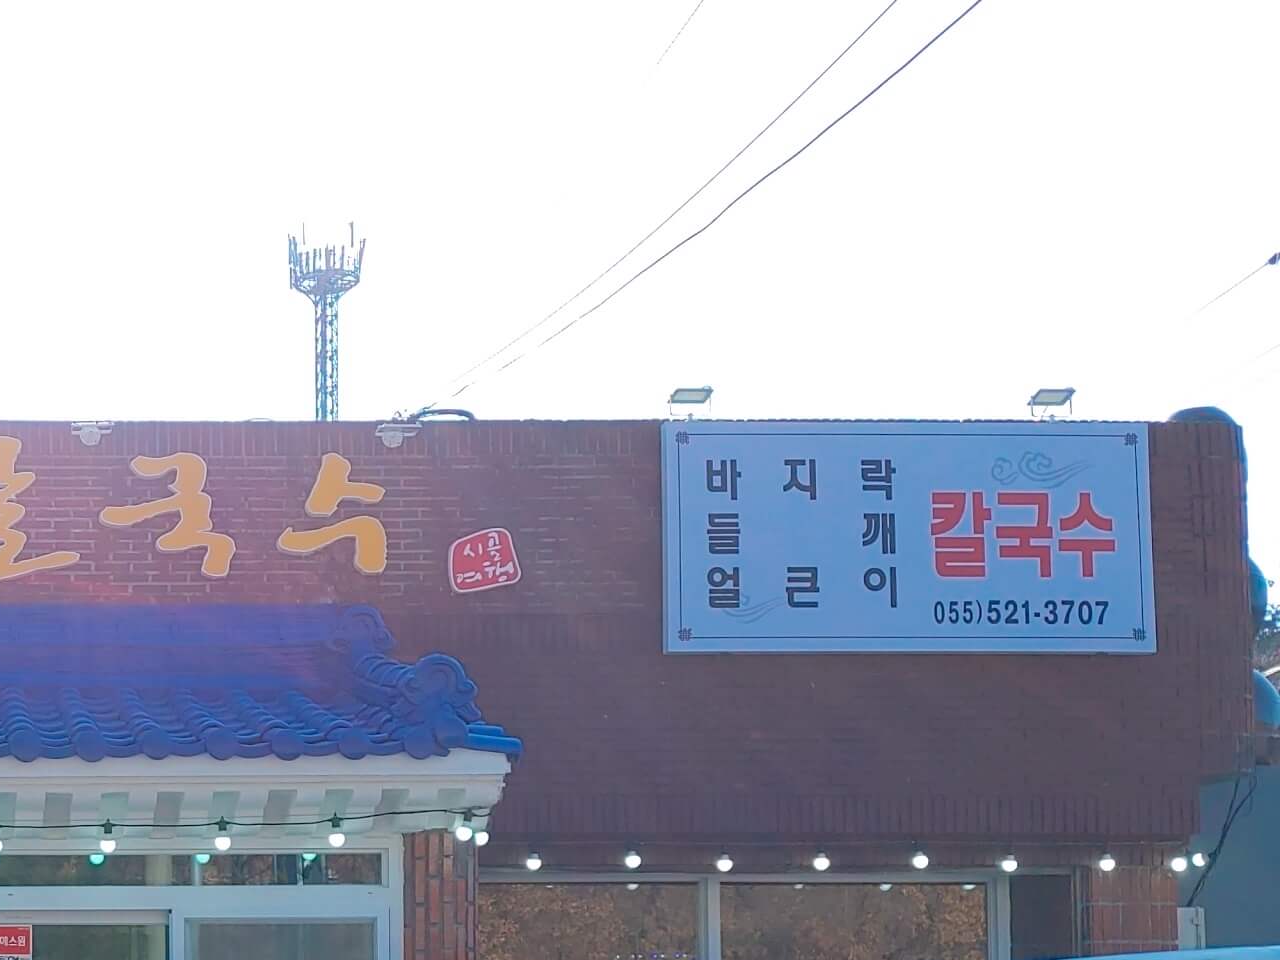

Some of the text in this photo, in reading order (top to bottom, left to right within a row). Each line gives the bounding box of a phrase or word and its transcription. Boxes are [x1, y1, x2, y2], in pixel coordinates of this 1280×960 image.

[706, 458, 897, 501] 바지락
[463, 532, 503, 561] 시골
[930, 490, 1117, 579] 칼국수
[456, 561, 515, 583] 여행
[707, 566, 898, 609] 얼큰이
[933, 599, 1110, 626] 055)521-3707
[0, 935, 26, 947] 에스원
